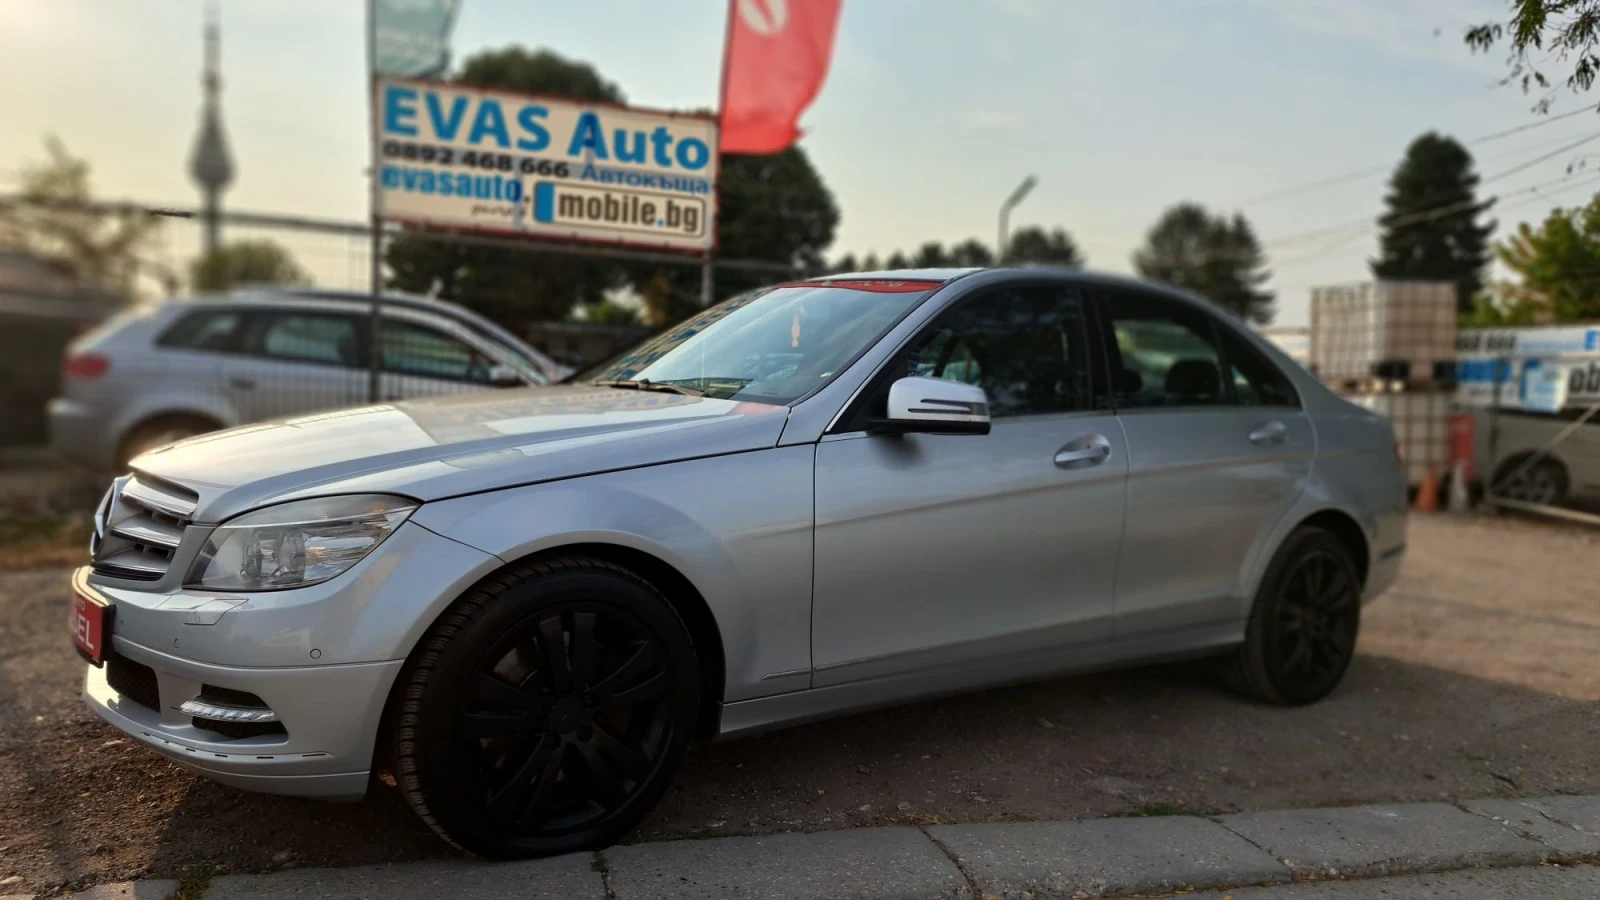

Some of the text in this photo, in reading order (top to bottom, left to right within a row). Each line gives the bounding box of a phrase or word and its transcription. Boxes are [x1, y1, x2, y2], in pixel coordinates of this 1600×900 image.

[382, 85, 710, 171] EVAS Auto
[382, 140, 570, 179] 0892 468 666
[580, 163, 710, 195] Автокъща
[558, 192, 699, 232] mobile.bg
